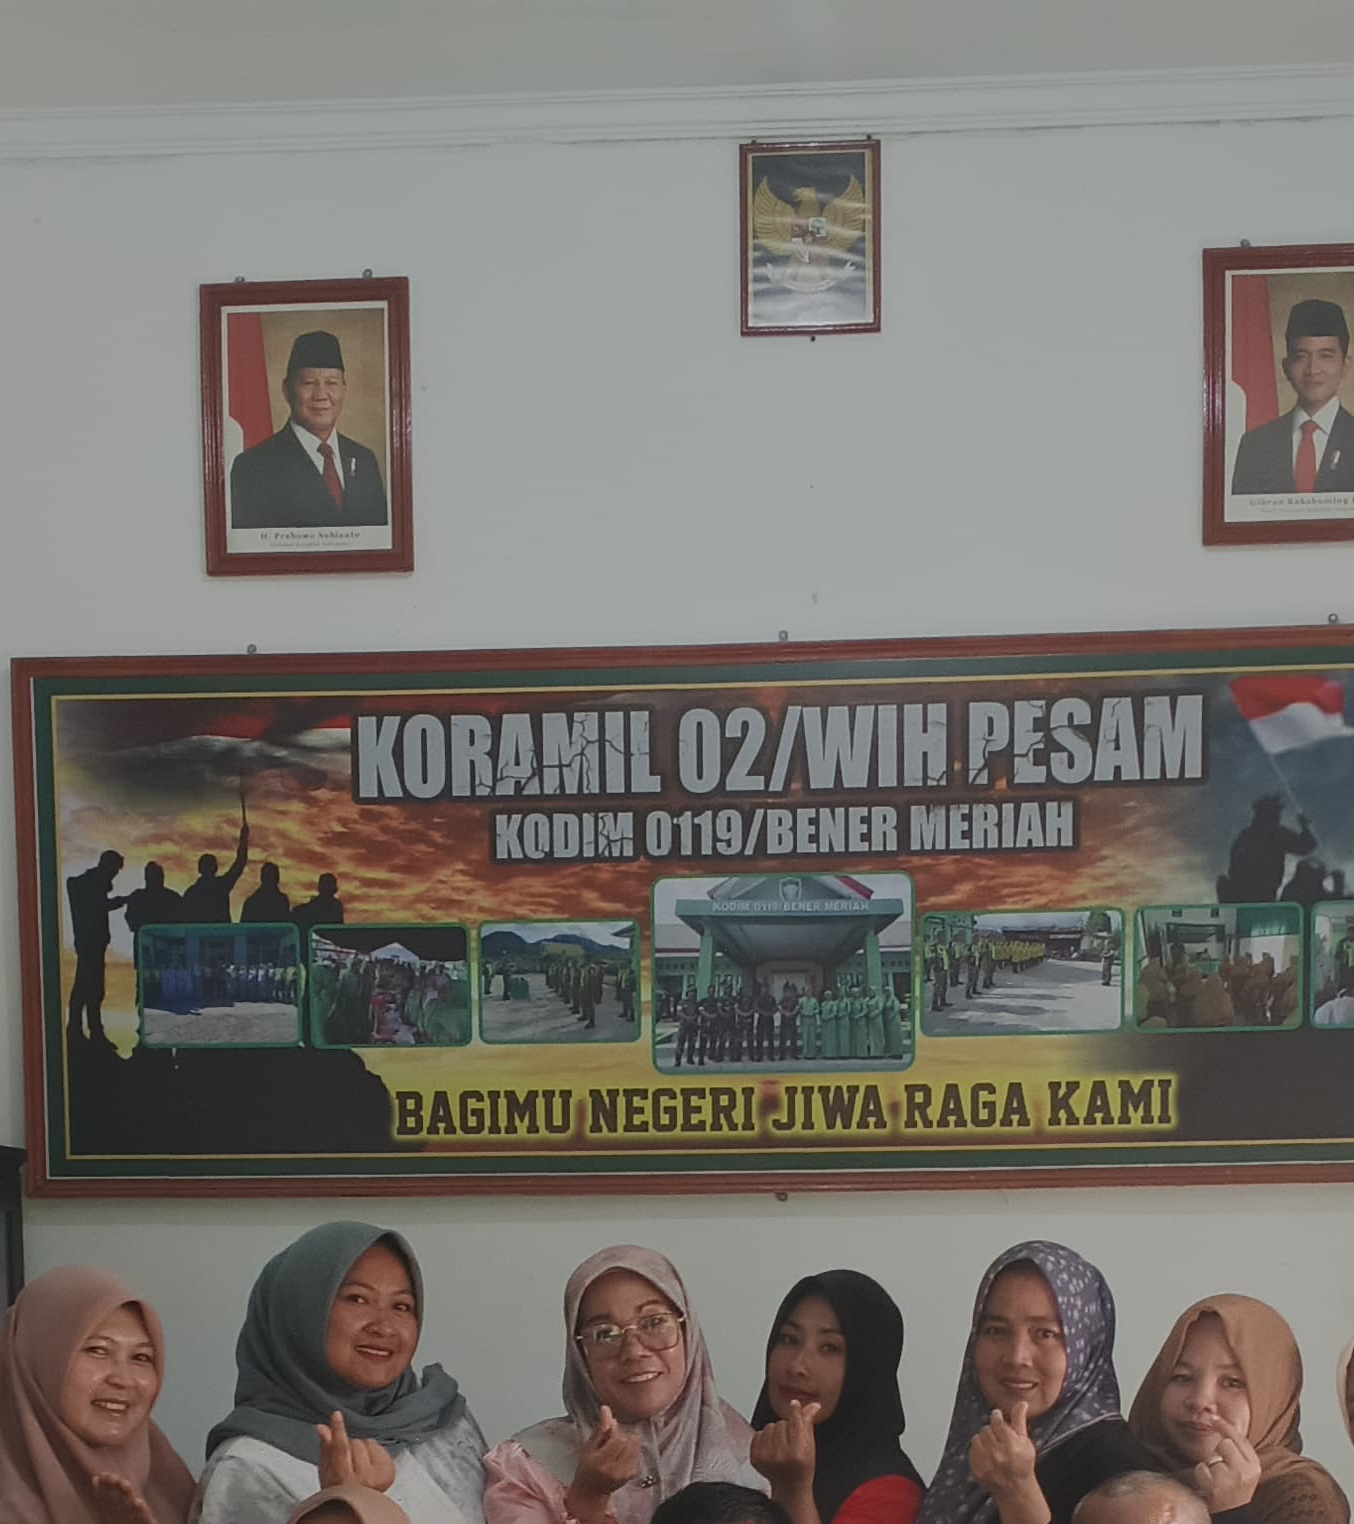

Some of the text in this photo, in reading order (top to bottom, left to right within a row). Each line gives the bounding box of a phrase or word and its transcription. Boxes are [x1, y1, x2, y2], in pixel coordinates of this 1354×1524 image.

[357, 694, 1204, 799] KORAMIL 02/WIH PESAM
[495, 800, 1074, 861] KODIM 0119/BENER MERIAH
[395, 1077, 1173, 1136] BAGIMU NEGERI JIWA RAGA KAMI
